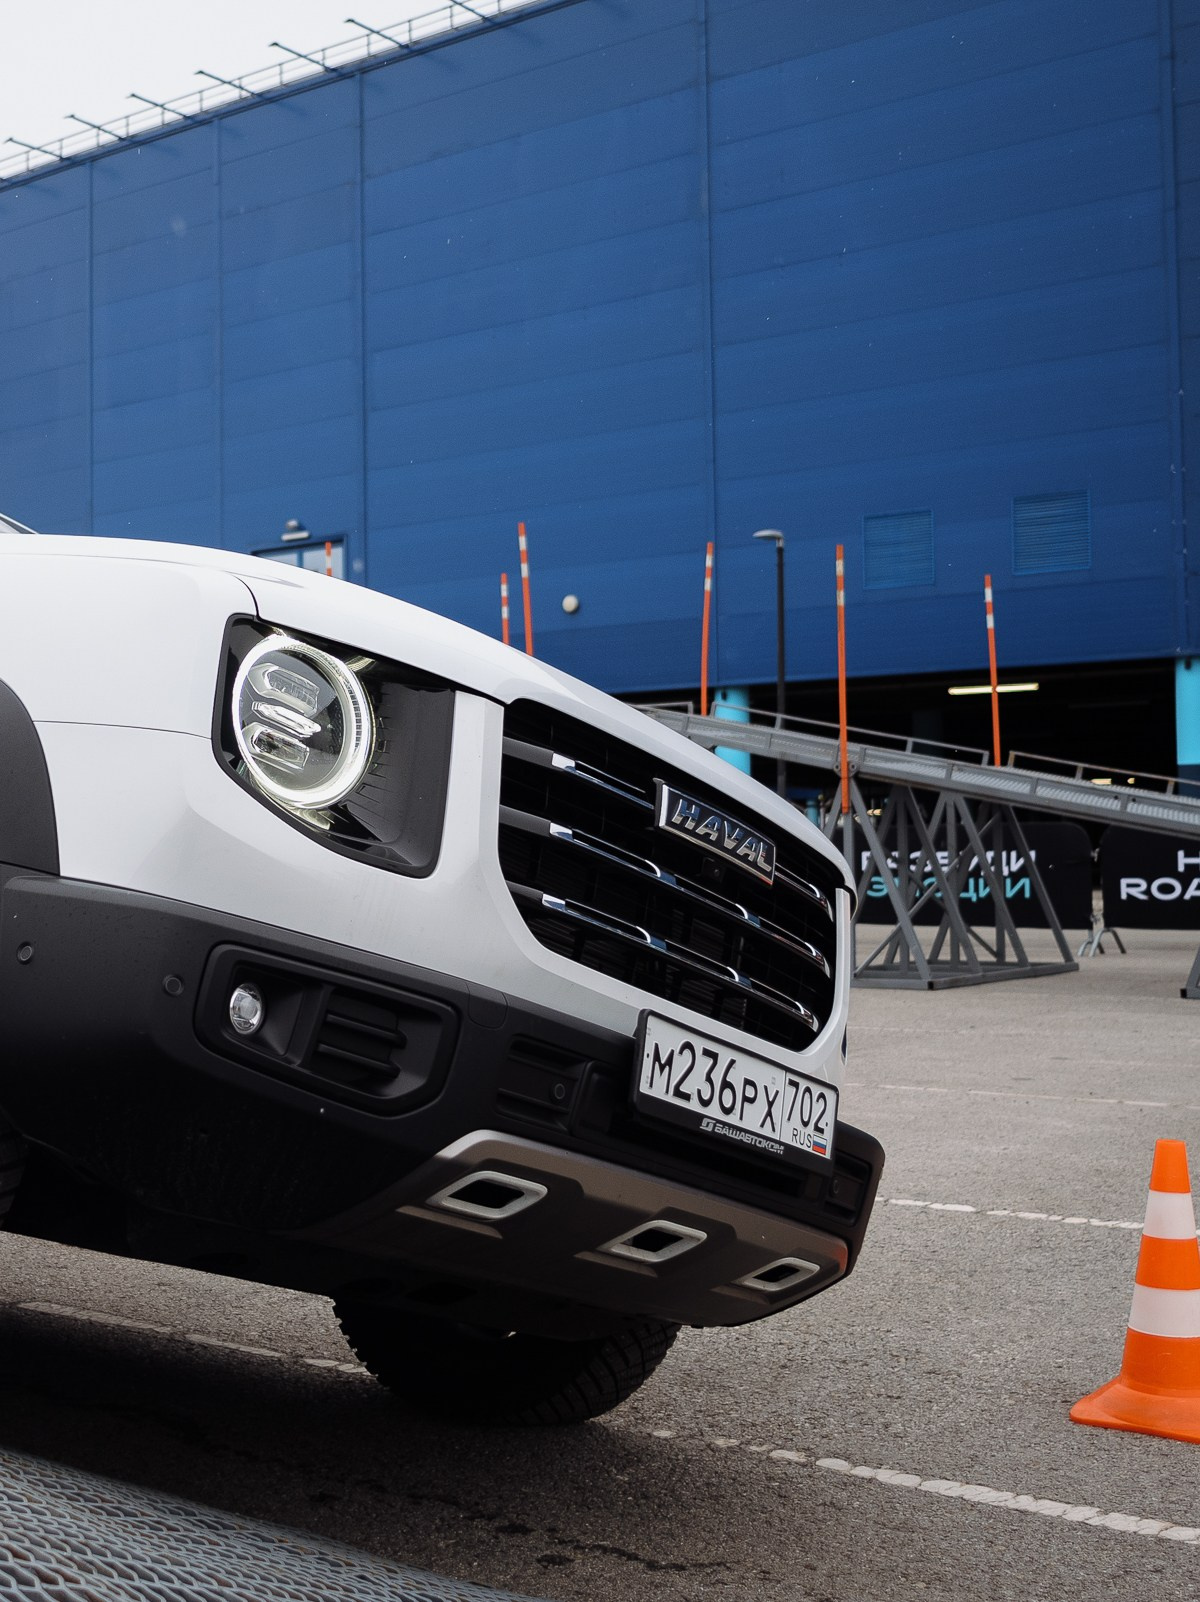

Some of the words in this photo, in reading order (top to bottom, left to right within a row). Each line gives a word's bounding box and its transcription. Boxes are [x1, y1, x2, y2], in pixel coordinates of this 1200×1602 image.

[671, 798, 773, 872] HAVAL
[786, 1078, 828, 1135] 702
[714, 1123, 785, 1155] БАШАВТОКОМ
[791, 1127, 813, 1149] RUS
